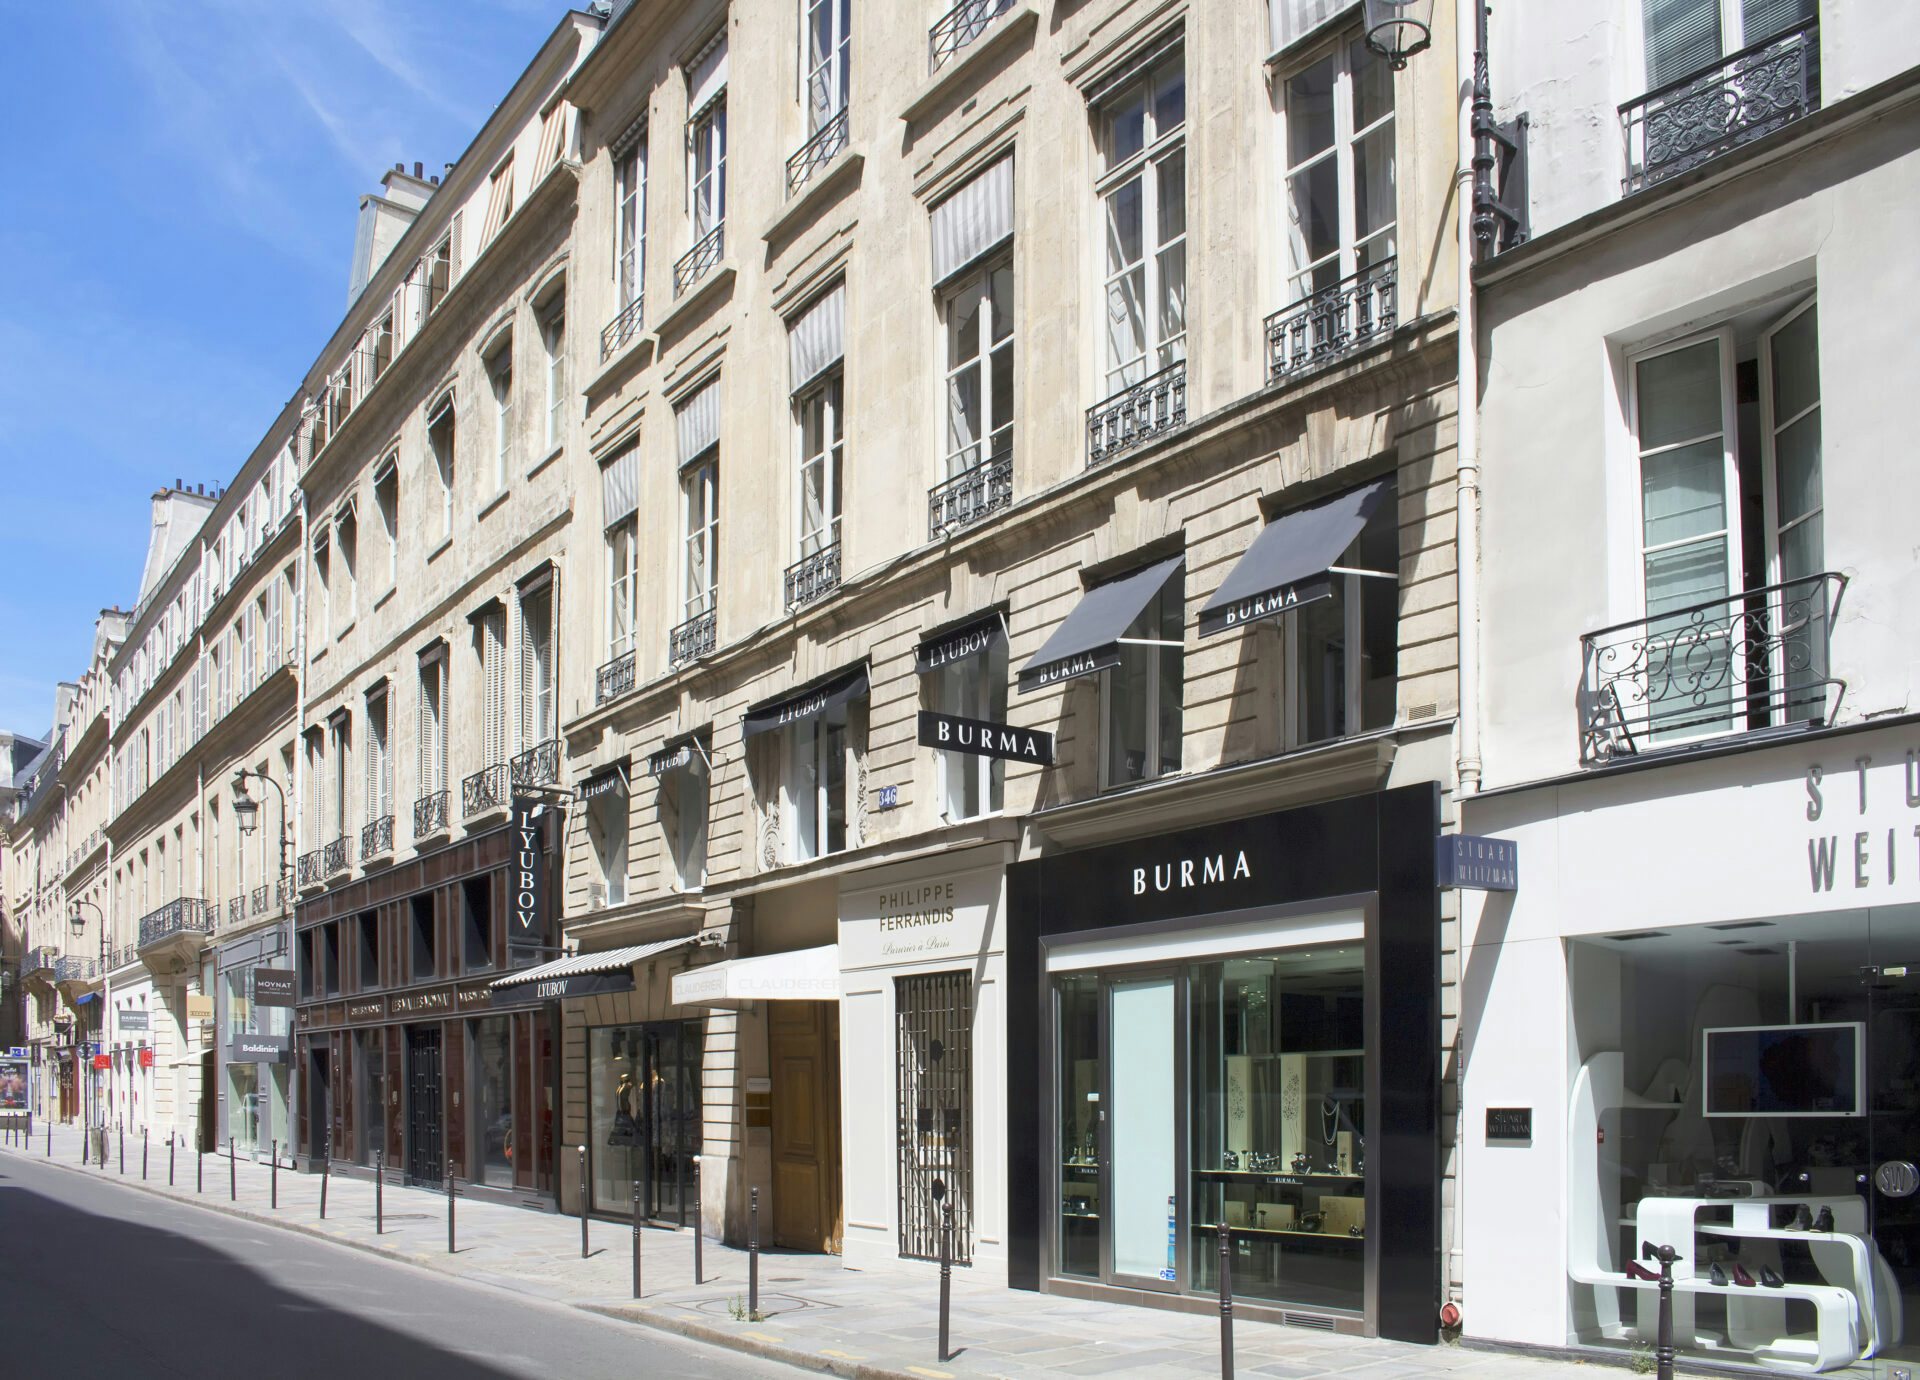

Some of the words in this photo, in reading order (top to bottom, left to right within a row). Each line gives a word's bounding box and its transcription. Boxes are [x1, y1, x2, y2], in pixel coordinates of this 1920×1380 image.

[1225, 585, 1299, 625] BURMA
[929, 626, 992, 668] LYUBOV
[1038, 652, 1096, 684] BURMA
[778, 689, 829, 724] LYUBOV
[938, 720, 1038, 756] BURMA
[585, 774, 616, 798] LYUBOV
[879, 787, 897, 806] 346
[1457, 840, 1514, 862] STUART
[517, 811, 536, 929] LYUBOV
[1133, 850, 1251, 895] BURMA
[1458, 864, 1515, 886] WEITZMAN
[880, 883, 954, 910] PHILIPPE
[880, 906, 954, 932] FERRANDIS
[926, 936, 950, 949] Paris
[257, 981, 292, 989] MOYNAT
[537, 980, 568, 998] LYUBOV
[242, 1044, 279, 1053] Baldinini
